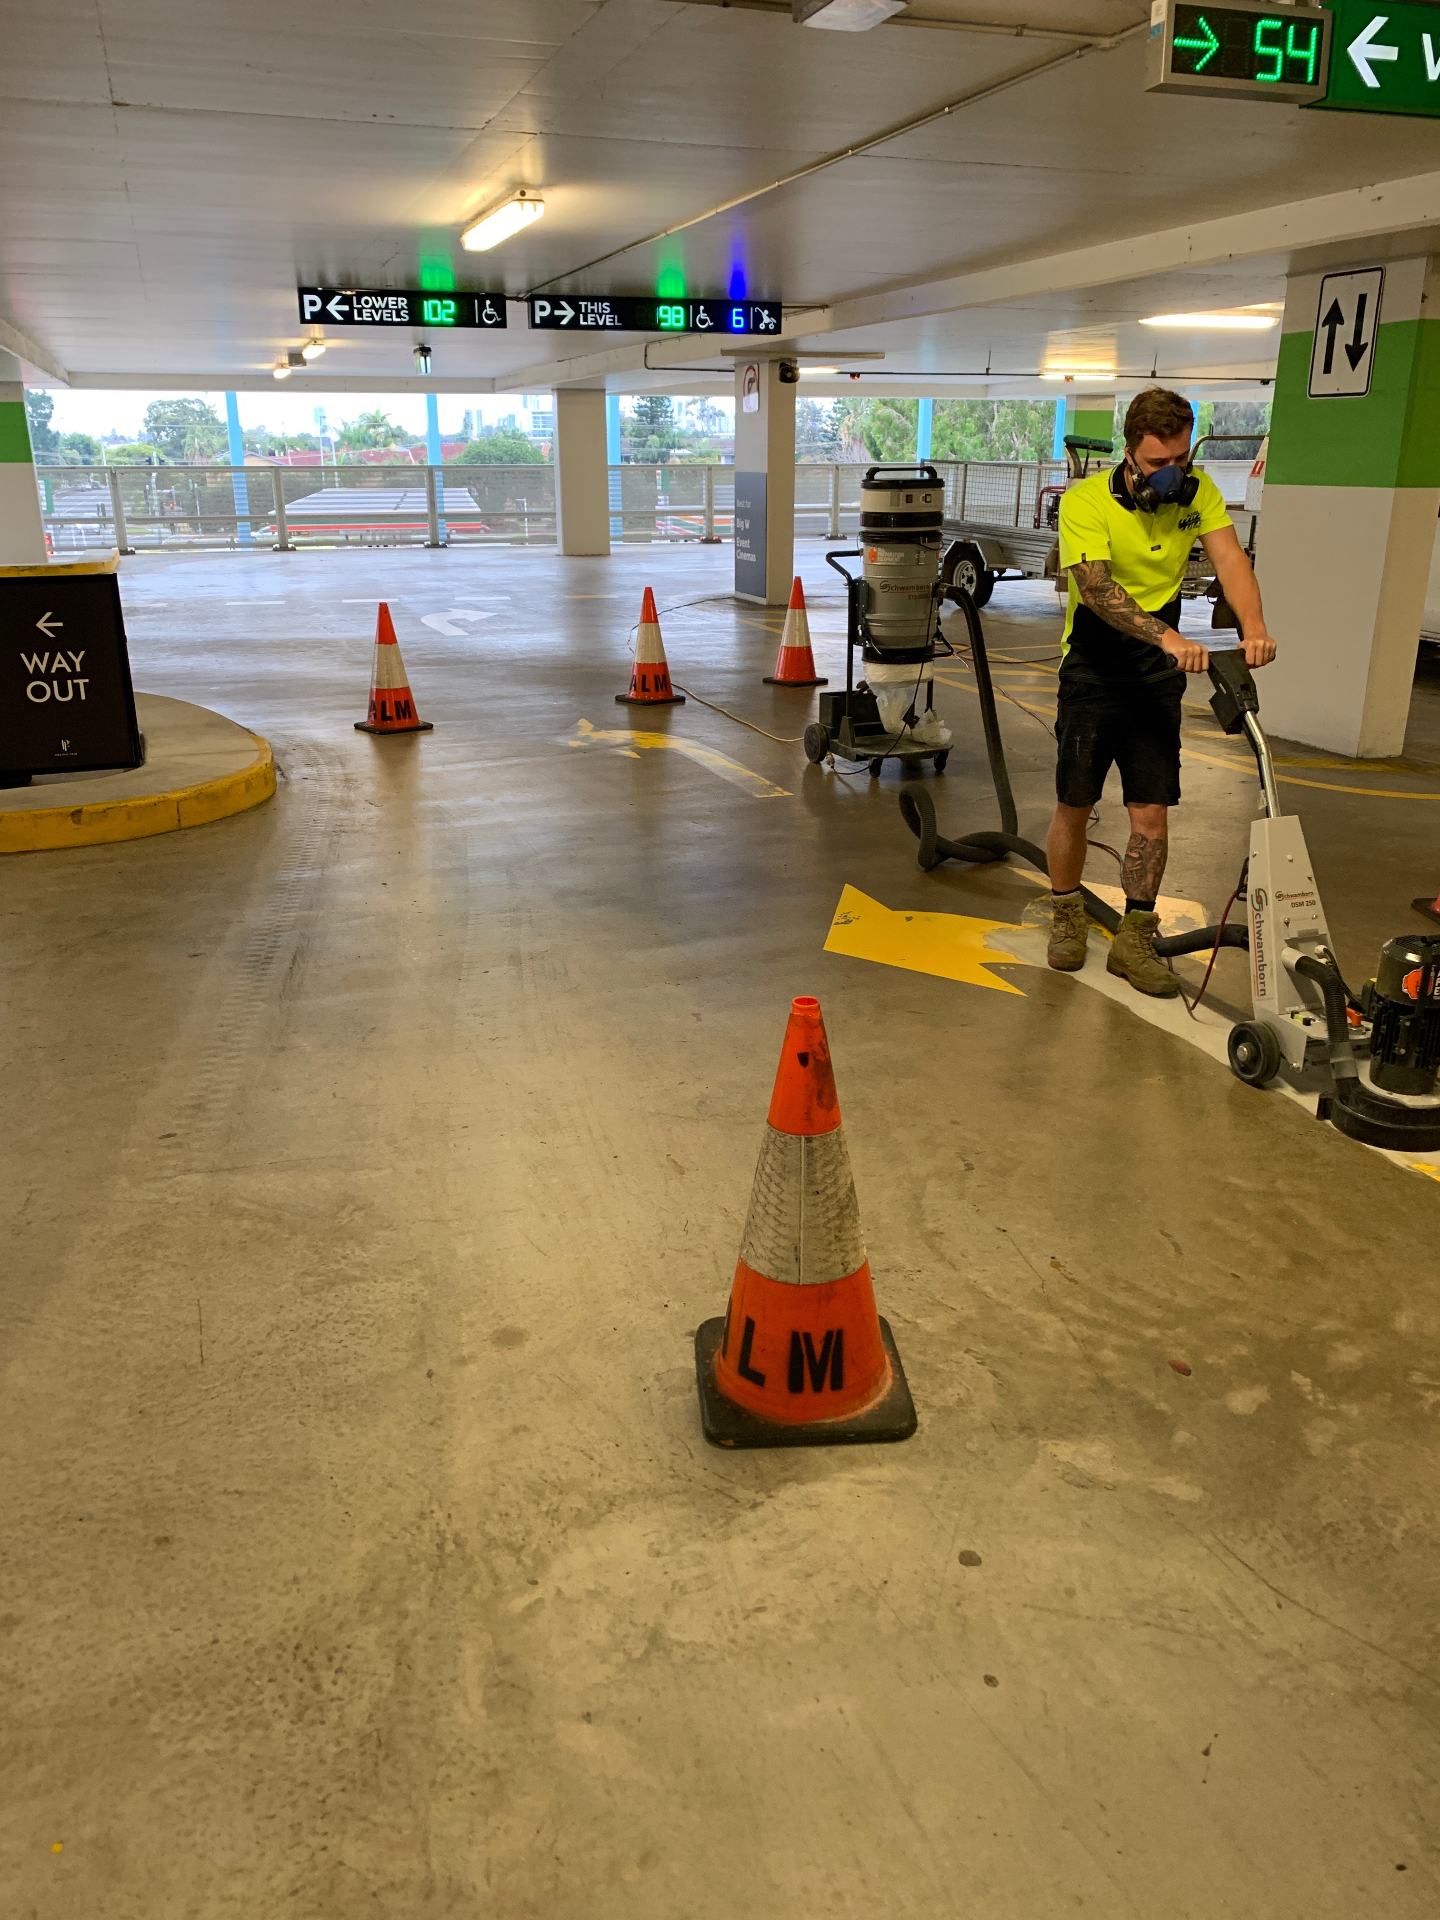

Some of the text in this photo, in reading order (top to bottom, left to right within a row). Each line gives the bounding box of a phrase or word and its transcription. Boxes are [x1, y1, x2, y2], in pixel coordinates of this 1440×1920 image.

[1254, 19, 1319, 83] 54
[303, 294, 322, 320] P
[353, 296, 408, 310] LOWER
[423, 300, 455, 322] 102
[535, 300, 550, 323] P
[579, 302, 611, 314] THIS
[354, 309, 410, 322] LEVELS
[579, 314, 623, 326] LEVEL
[660, 305, 684, 327] 98
[732, 308, 744, 328] 6
[736, 518, 750, 531] Big W
[736, 537, 750, 548] Event
[736, 549, 756, 562] Cinemas
[879, 580, 930, 593] Schwamborn
[20, 651, 86, 675] WAY
[26, 678, 90, 703] OUT
[1275, 891, 1315, 902] Schwamborn
[1305, 900, 1316, 908] 250
[1251, 888, 1268, 997] Schwamborn
[722, 1294, 843, 1393] LM
